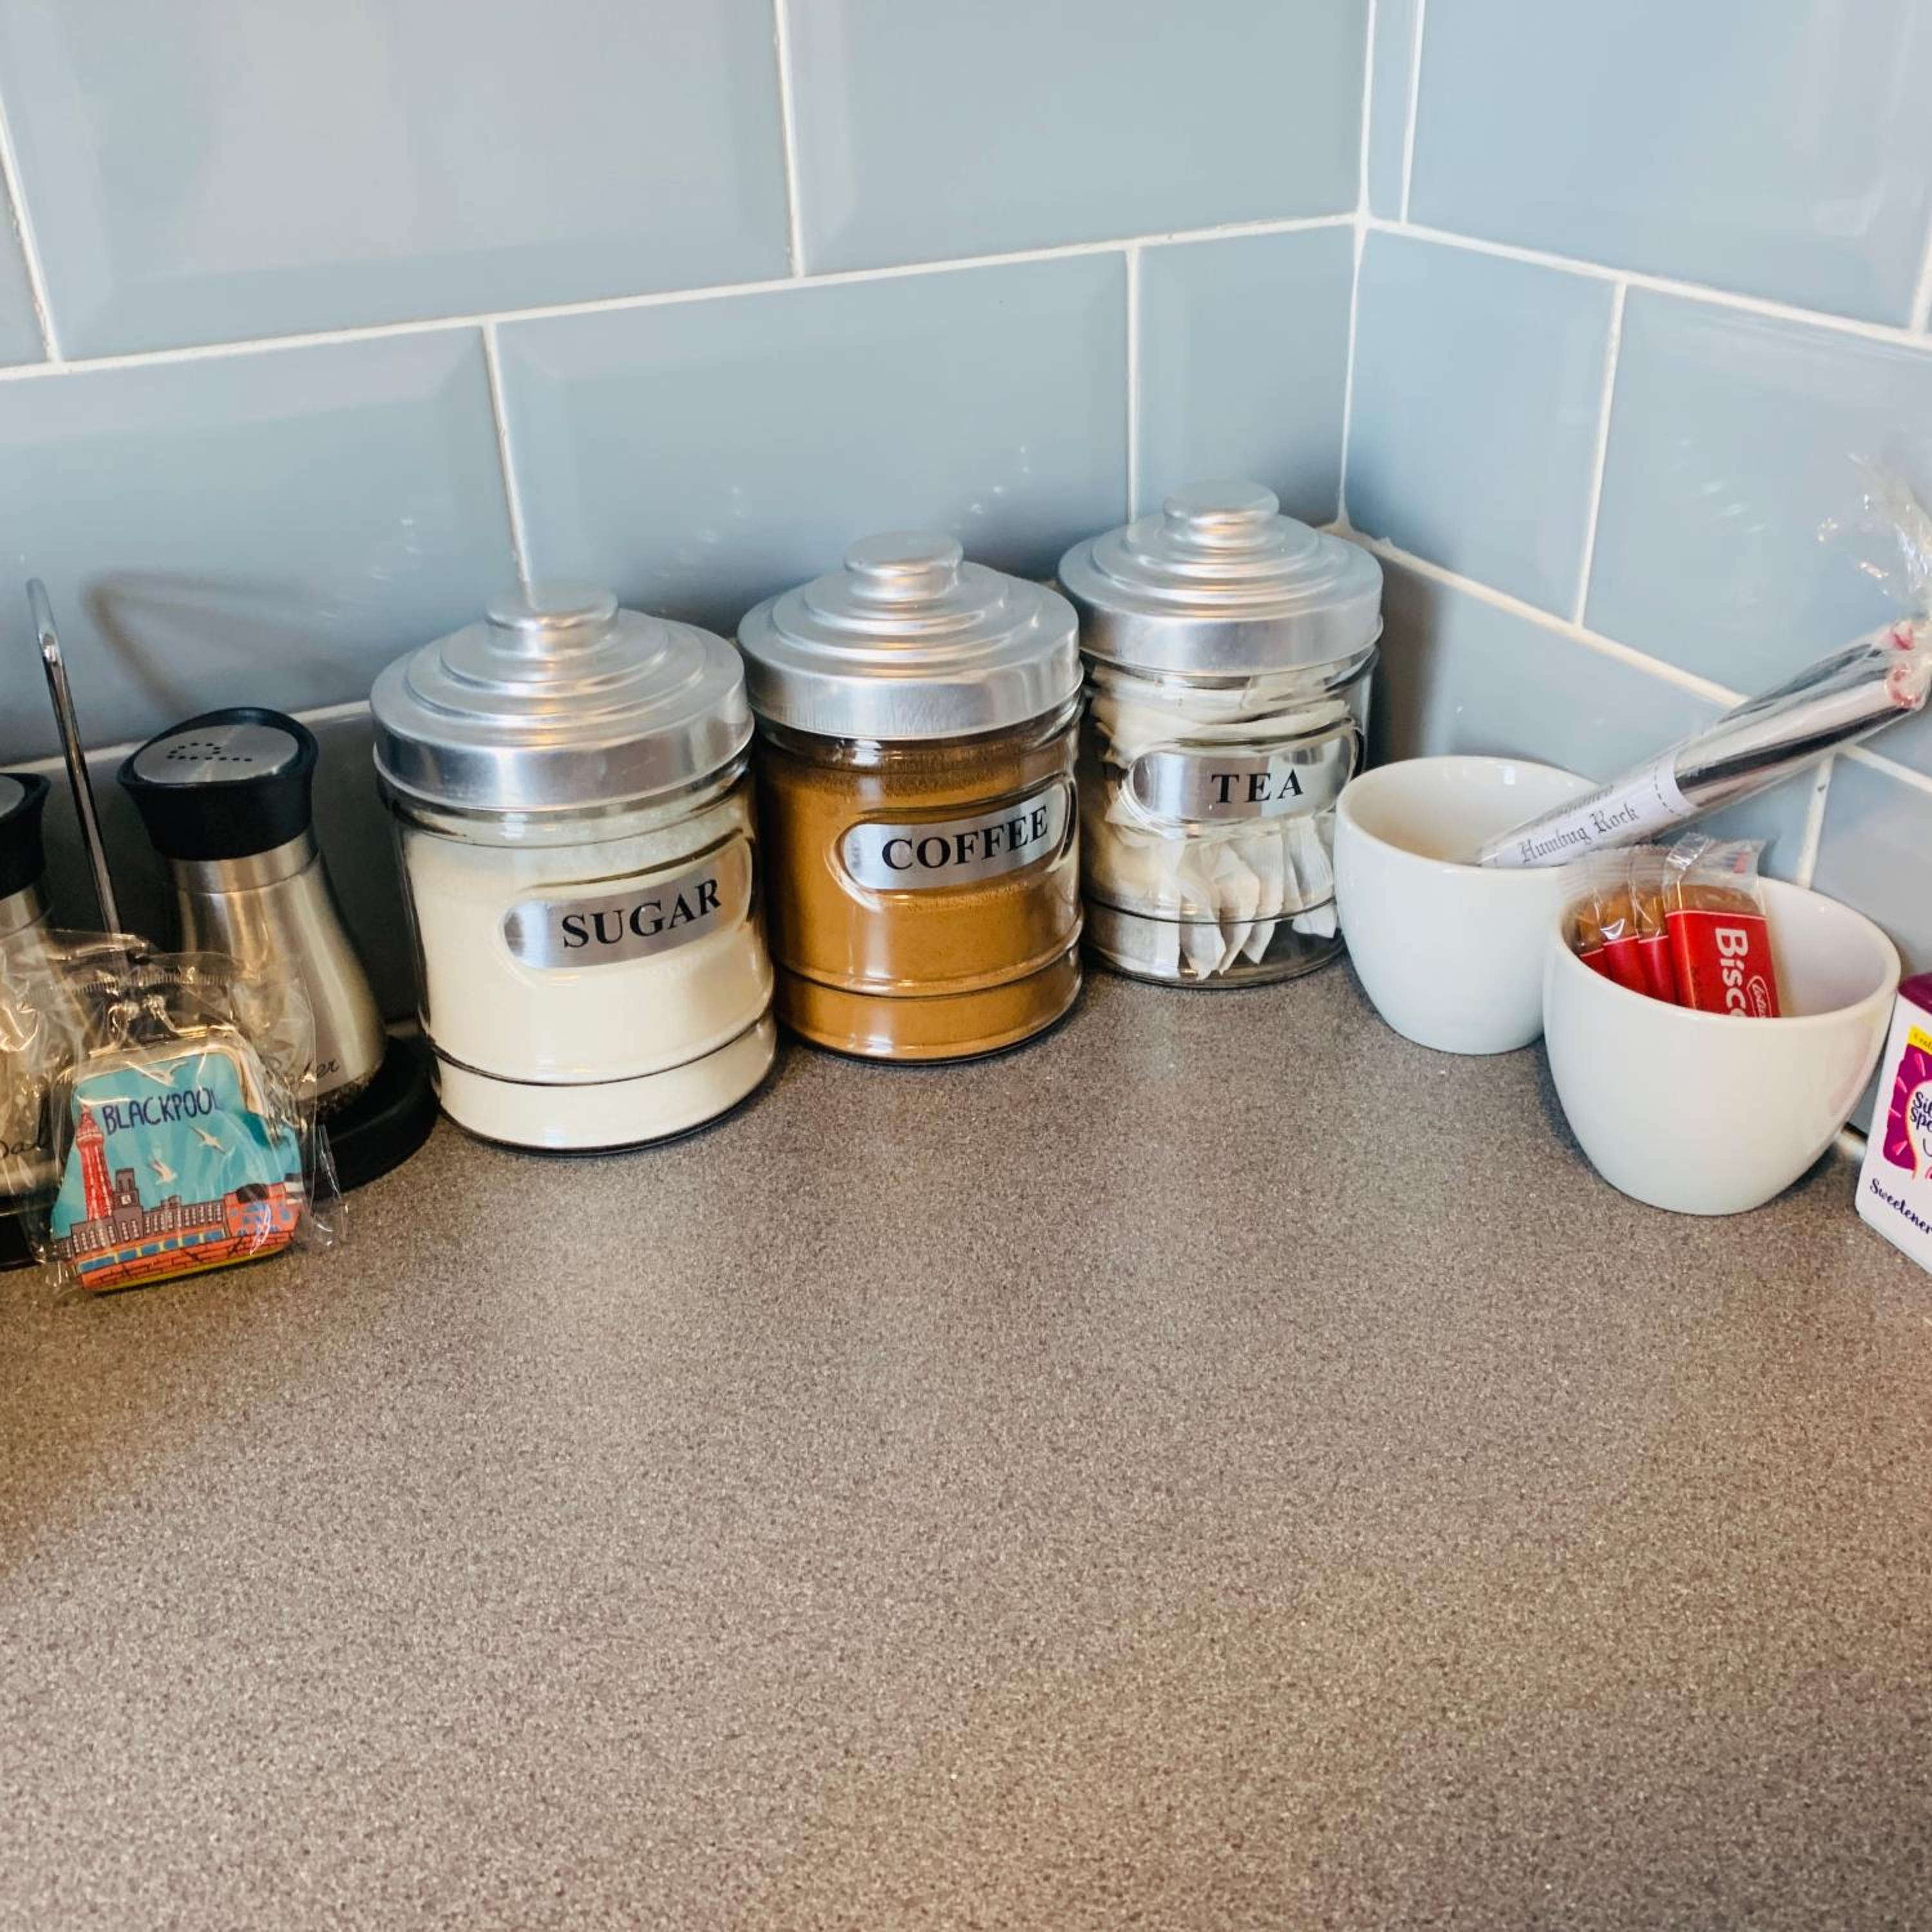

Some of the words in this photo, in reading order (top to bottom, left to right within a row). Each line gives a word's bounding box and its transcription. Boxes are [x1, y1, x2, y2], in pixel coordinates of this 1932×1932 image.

[1211, 768, 1304, 804] TEA
[882, 806, 1048, 870] COFFEE
[1517, 827, 1594, 864] Humbug
[1589, 804, 1641, 836] Rock
[562, 878, 721, 948] SUGAR
[102, 1087, 223, 1136] BLACKPOOL
